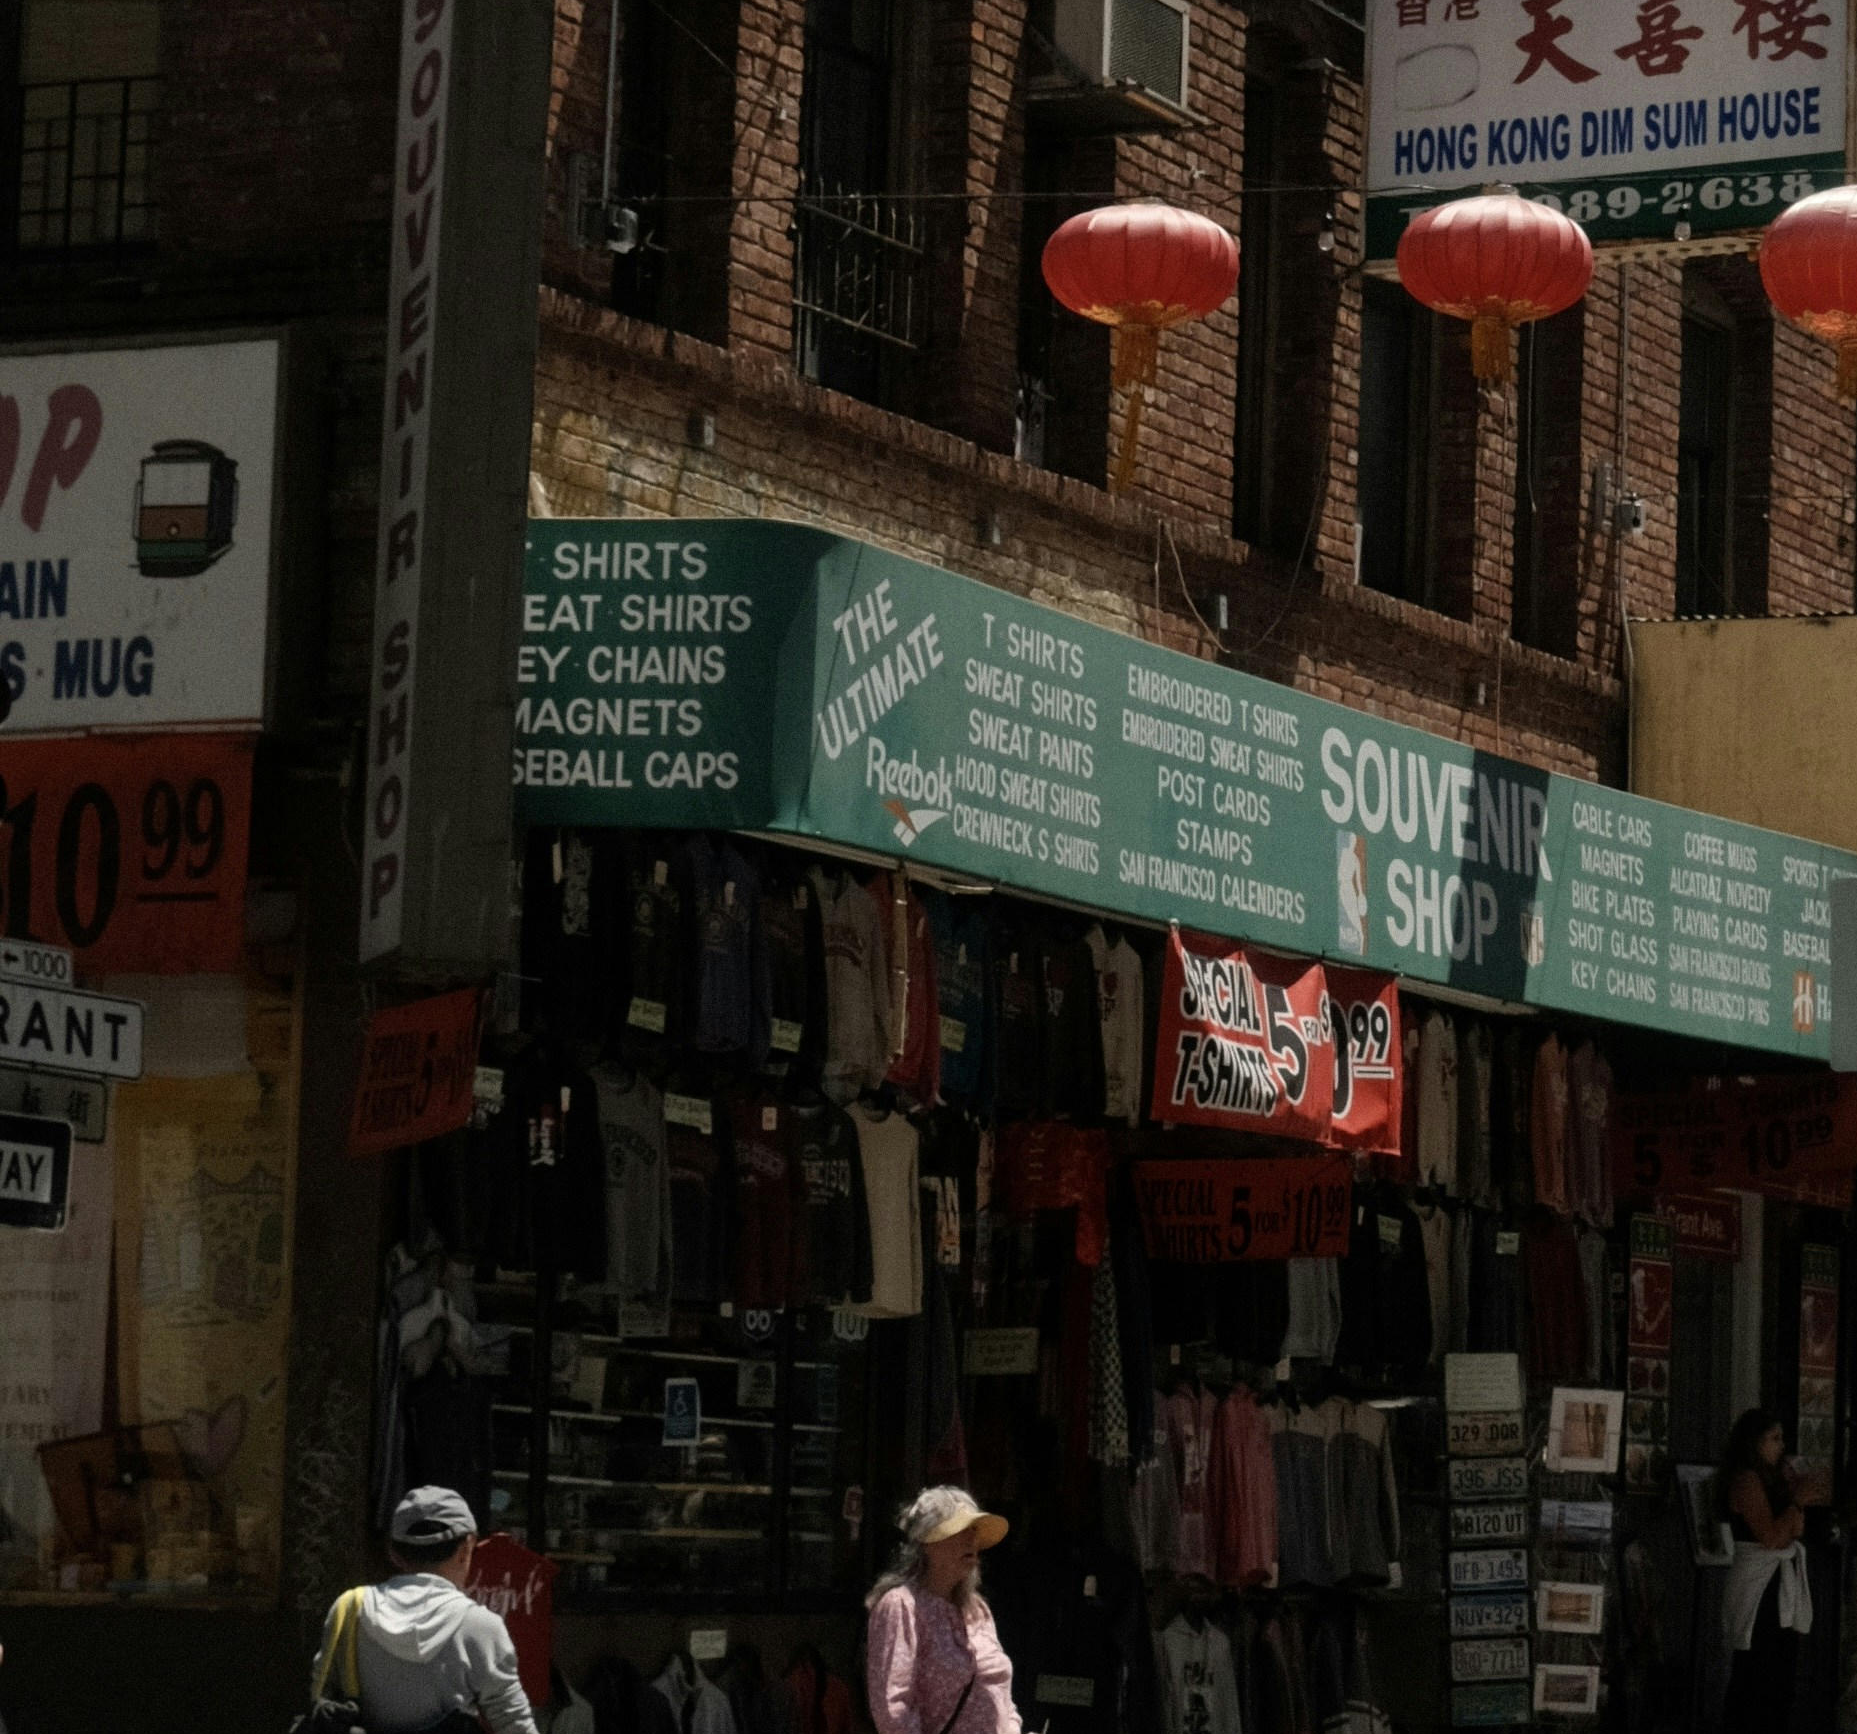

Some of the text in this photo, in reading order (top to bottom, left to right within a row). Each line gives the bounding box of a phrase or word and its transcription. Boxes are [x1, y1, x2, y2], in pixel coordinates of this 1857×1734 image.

[1394, 87, 1820, 175] HONG KONG DIM SUM HOUSE
[552, 541, 709, 581] SHIRTS
[520, 594, 753, 634] EAT SHIRTS
[833, 579, 898, 665] THE
[982, 612, 1085, 680] T SHIRTS
[53, 637, 153, 701] MUG
[516, 644, 726, 685] EY CHAINS
[818, 613, 944, 761] ULTIMATE
[964, 658, 1098, 731] SWEAT SHIRTS
[1128, 662, 1300, 748] EMBROIDERED T SHIRTS
[369, 618, 411, 924] SHOP
[645, 751, 739, 789] CAPS
[865, 736, 955, 807] Reebok
[968, 710, 1095, 780] SWEAT PANTS
[1122, 709, 1304, 795] EMBROIDERED SWEAT SHIRTS
[955, 755, 1101, 829] HOOD SWEAT SHIRTS
[1157, 765, 1272, 827] POST CARDS
[1320, 727, 1554, 883] SOUVENIR
[1572, 799, 1653, 849] CABLE CARS
[140, 779, 223, 881] 99
[952, 804, 1100, 876] CREWNECK S SHIRTS
[1176, 818, 1254, 867] STAMPS
[1684, 830, 1758, 875] COFFEE MUGS
[1118, 848, 1306, 926] SAN FRANCISCO CALENDERS
[1581, 844, 1645, 886] MAGNETS
[1669, 865, 1772, 915] ALCATRAZ NOVELTY
[1783, 855, 1820, 889] SPORTS
[1386, 858, 1500, 967] SHOP
[1571, 879, 1656, 928] BIKE PLATES
[1672, 905, 1768, 952] PLAYING CARDS
[24, 949, 68, 980] 1000
[1568, 917, 1603, 952] SHOT
[1610, 929, 1659, 966] GLASS
[1667, 944, 1772, 990] SAN FRANCISCO BOOKS
[1571, 960, 1658, 1005] KEY CHAINS
[1668, 982, 1770, 1027] SAN FRANCISCO PINS
[1171, 1029, 1280, 1118] T-SHIRTS
[1262, 983, 1309, 1107] 5
[1350, 1000, 1391, 1065] 99
[0, 1150, 46, 1193] AY
[1633, 1132, 1662, 1186] 5
[1740, 1118, 1792, 1175] 10
[1139, 1178, 1217, 1216] SPECIAL
[1228, 1185, 1252, 1257] 5
